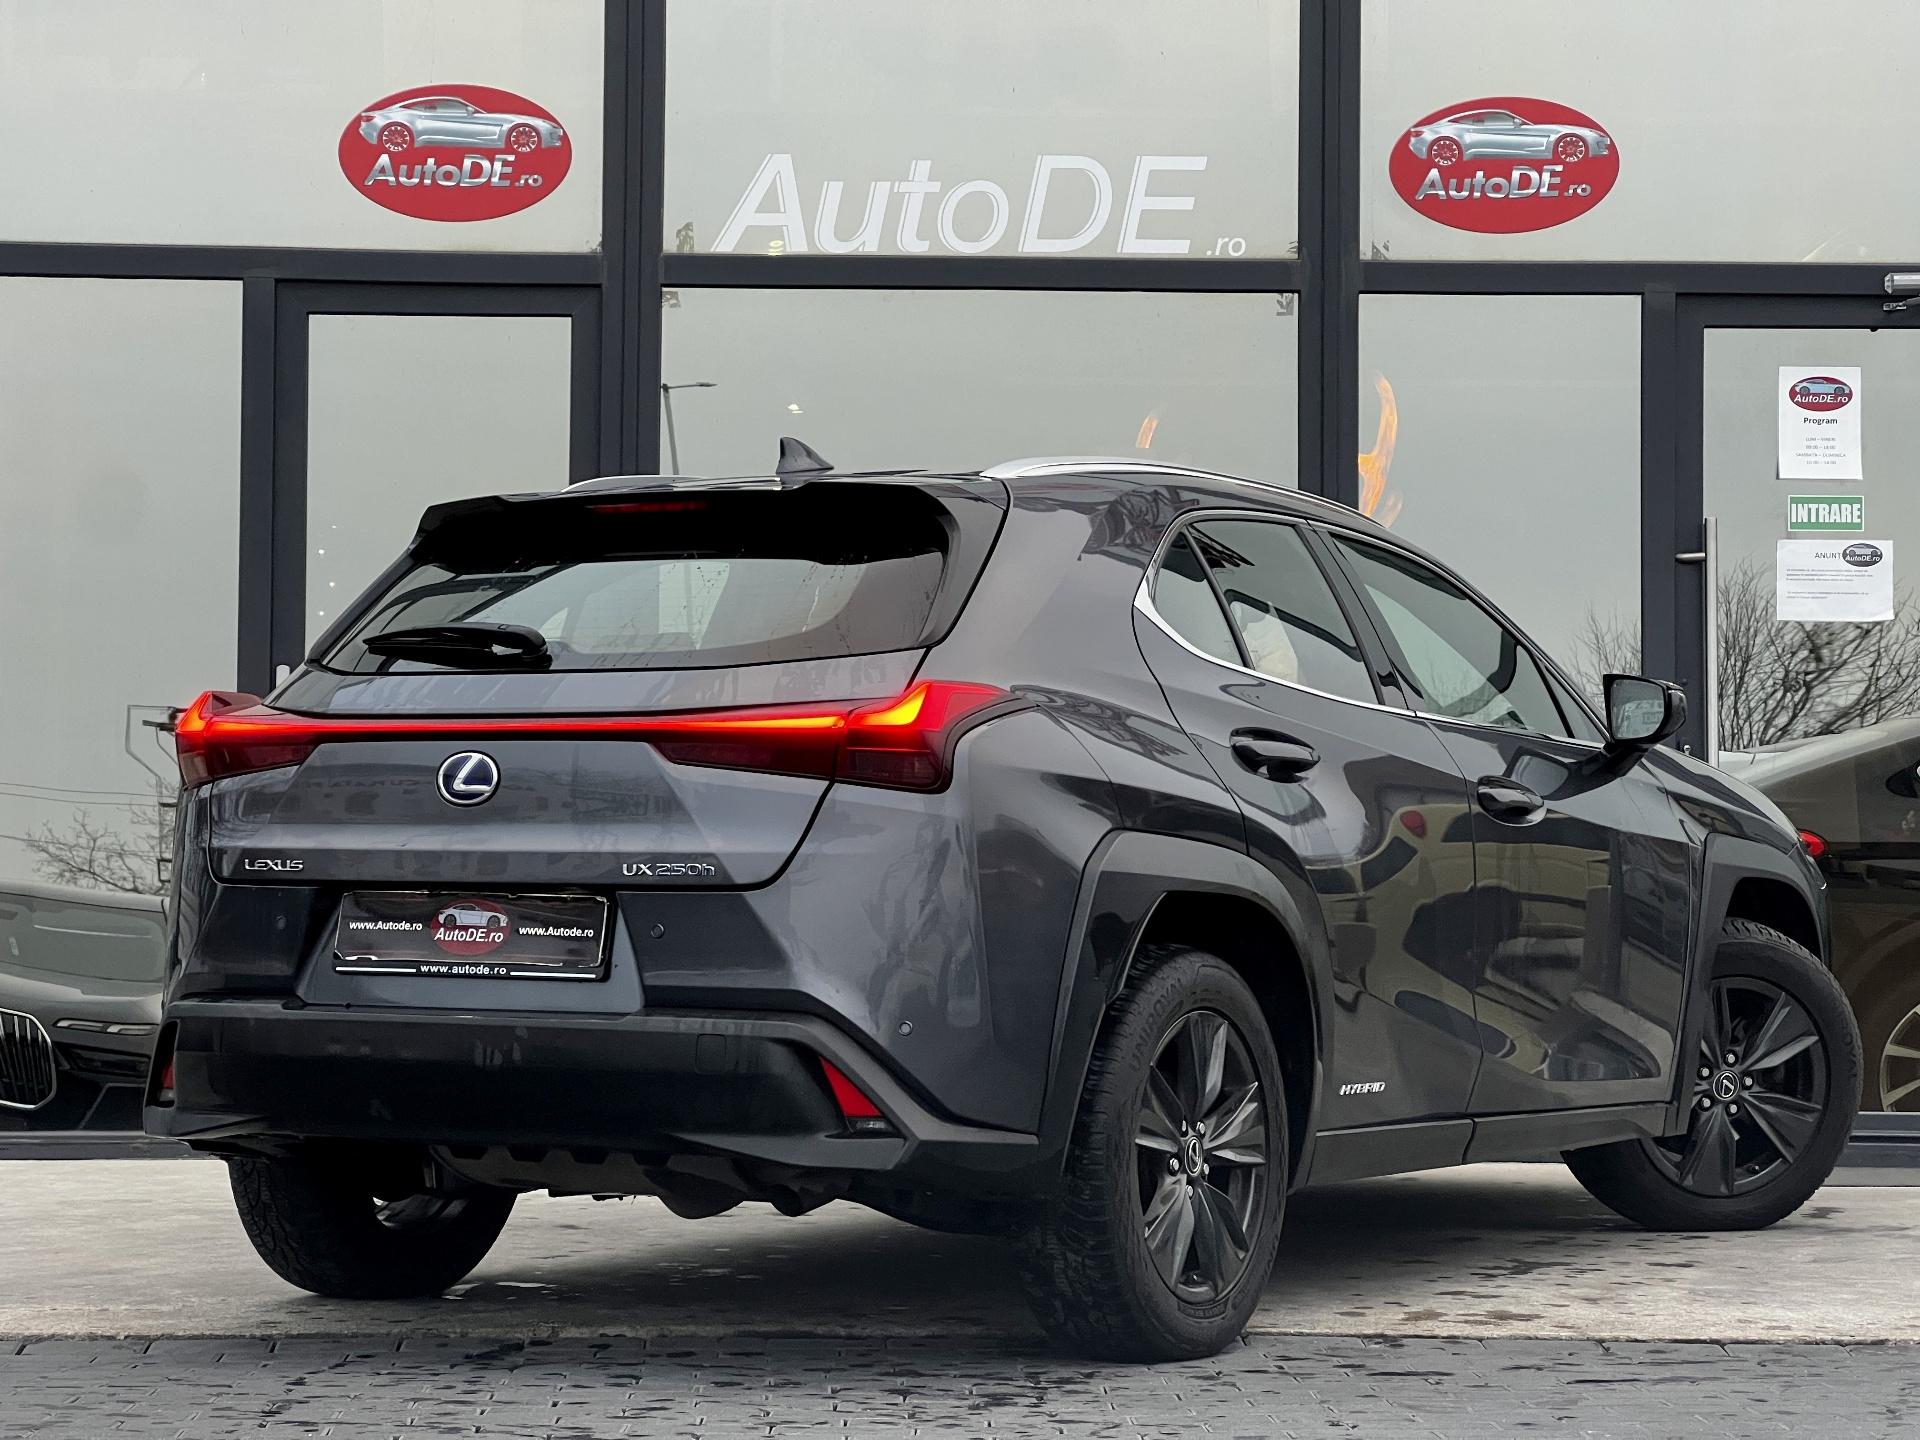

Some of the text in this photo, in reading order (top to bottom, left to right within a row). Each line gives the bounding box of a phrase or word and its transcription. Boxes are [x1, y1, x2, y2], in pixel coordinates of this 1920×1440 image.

[1794, 394, 1849, 403] AutoDE.ro
[1803, 417, 1838, 425] Program
[1791, 503, 1861, 523] INTRARE
[244, 858, 304, 871] LEXUS
[622, 863, 715, 876] UX 250h
[349, 920, 423, 931] www.Autode.ro
[518, 925, 594, 938] www.Autode.ro
[433, 927, 504, 943] AutoDE.ro
[420, 963, 507, 975] www.autode.ro
[1339, 1081, 1386, 1096] HYBRID
